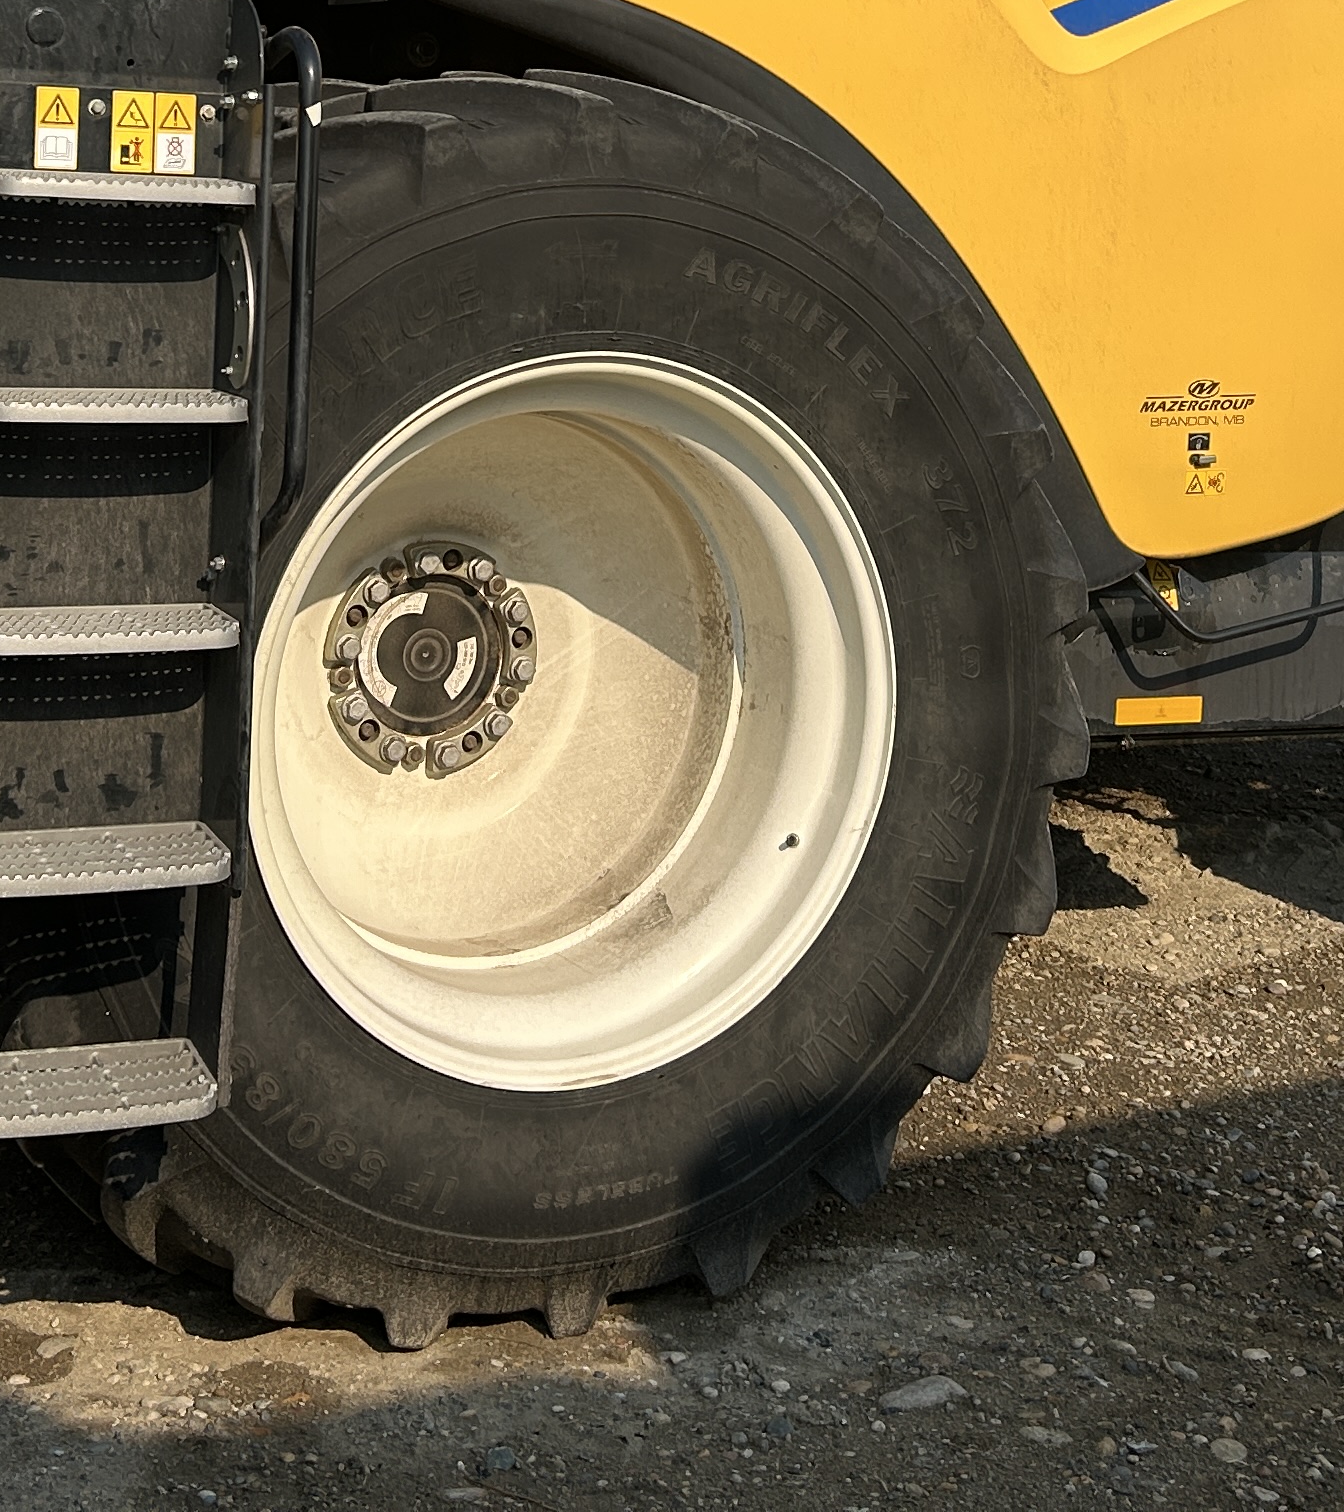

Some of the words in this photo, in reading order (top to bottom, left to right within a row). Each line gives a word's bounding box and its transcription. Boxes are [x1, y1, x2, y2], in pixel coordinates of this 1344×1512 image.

[682, 246, 911, 420] AGRIFLEX
[1139, 398, 1255, 413] MAZERGROUP
[1223, 414, 1245, 425] MB
[921, 454, 978, 557] 372
